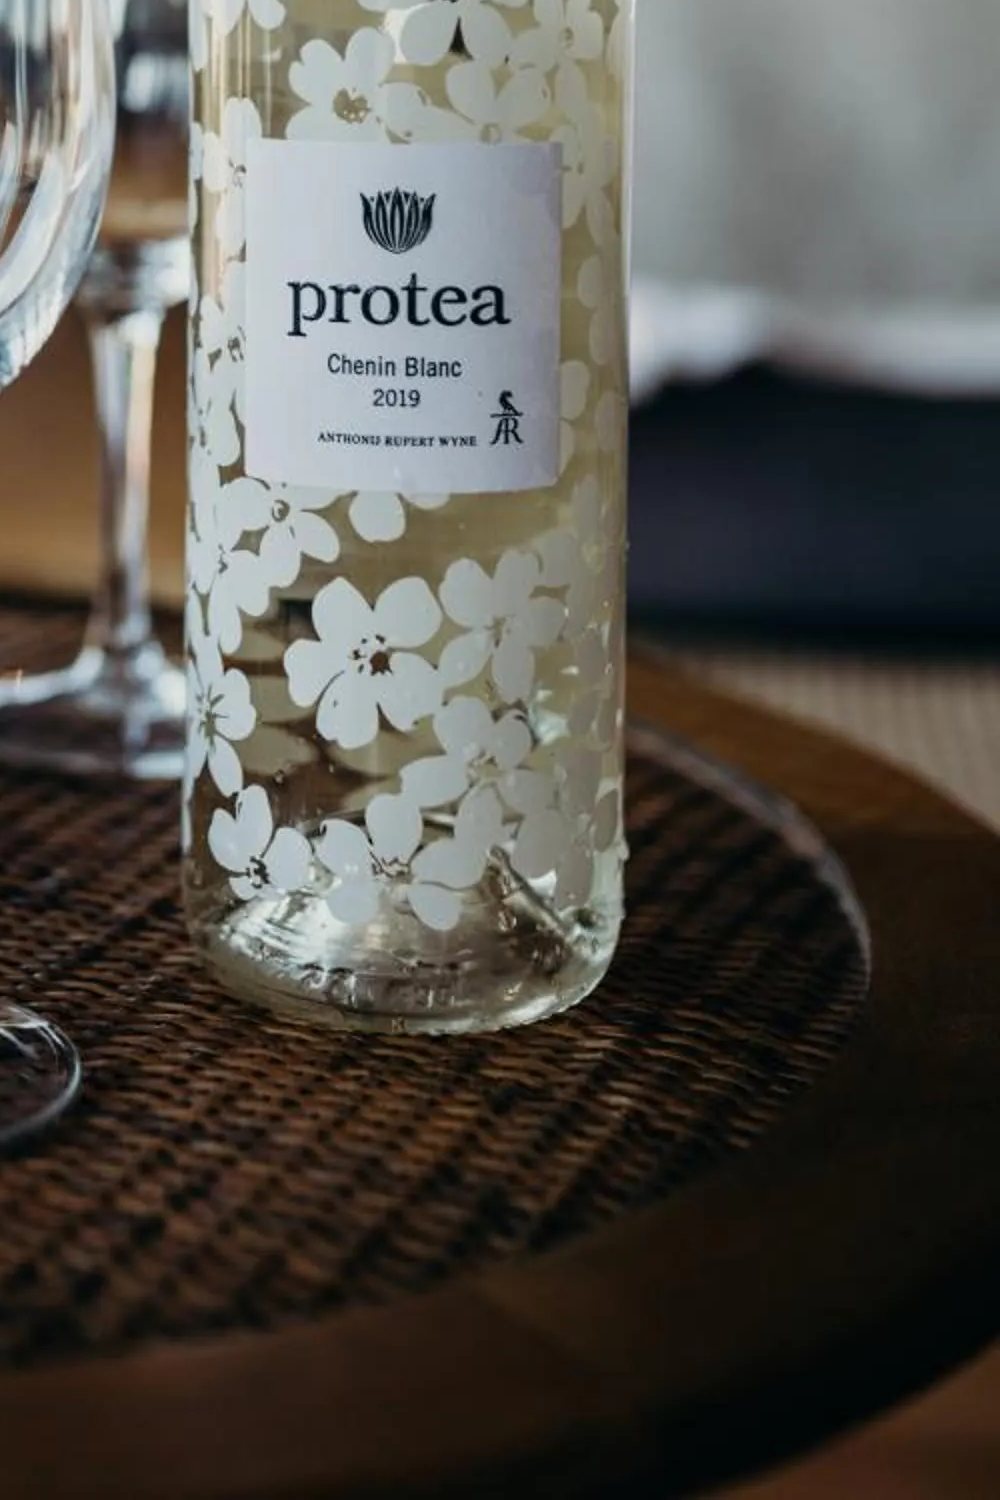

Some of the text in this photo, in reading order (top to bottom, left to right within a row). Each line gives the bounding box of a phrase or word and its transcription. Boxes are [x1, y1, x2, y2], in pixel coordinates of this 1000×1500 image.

[287, 273, 511, 337] protea
[327, 353, 463, 378] Chenin Blanc
[372, 388, 422, 408] 2019
[384, 435, 435, 447] RUPERT
[438, 435, 478, 447] WYNE
